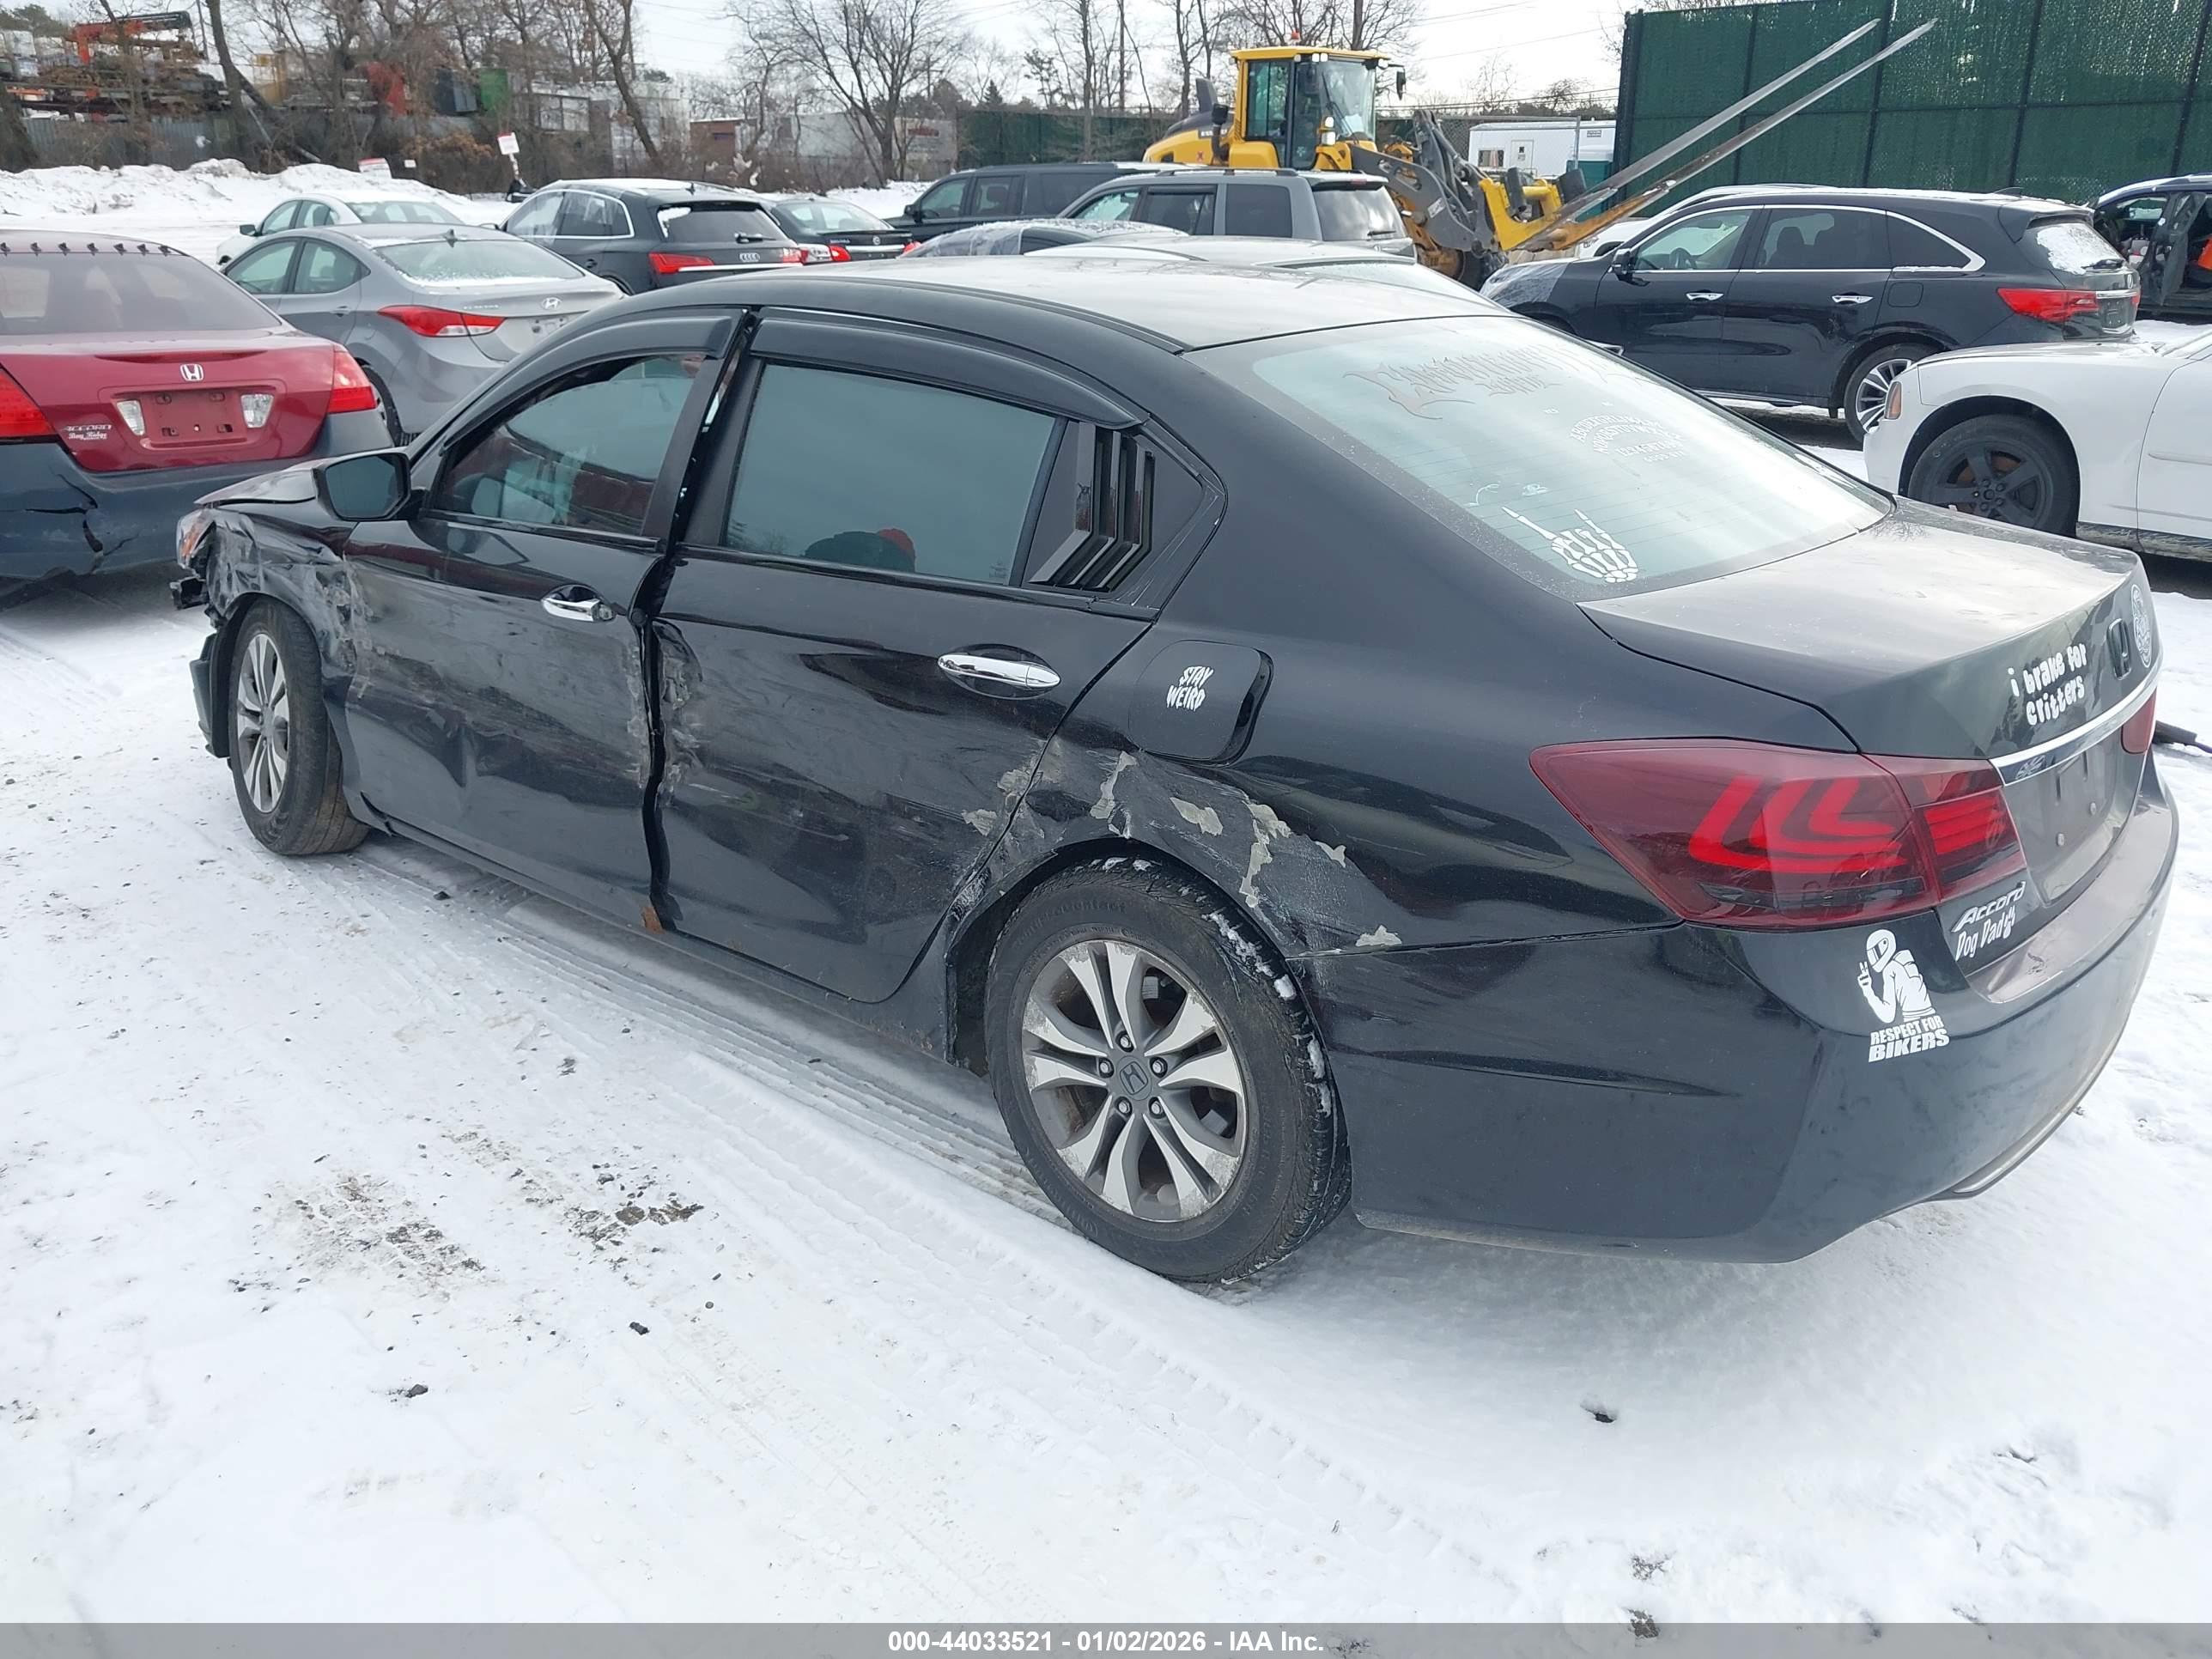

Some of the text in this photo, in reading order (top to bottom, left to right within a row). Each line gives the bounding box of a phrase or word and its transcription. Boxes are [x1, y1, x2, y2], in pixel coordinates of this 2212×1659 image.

[1179, 666, 1214, 689] STAY
[2008, 643, 2087, 696] i brake for
[1167, 685, 1206, 712] WEIRD
[2027, 676, 2085, 726] critters
[1951, 881, 2026, 933] Accord
[1955, 931, 1978, 961] Dog
[1869, 1029, 1950, 1062] BIKERS
[1871, 1015, 1945, 1045] RESPECT FOR
